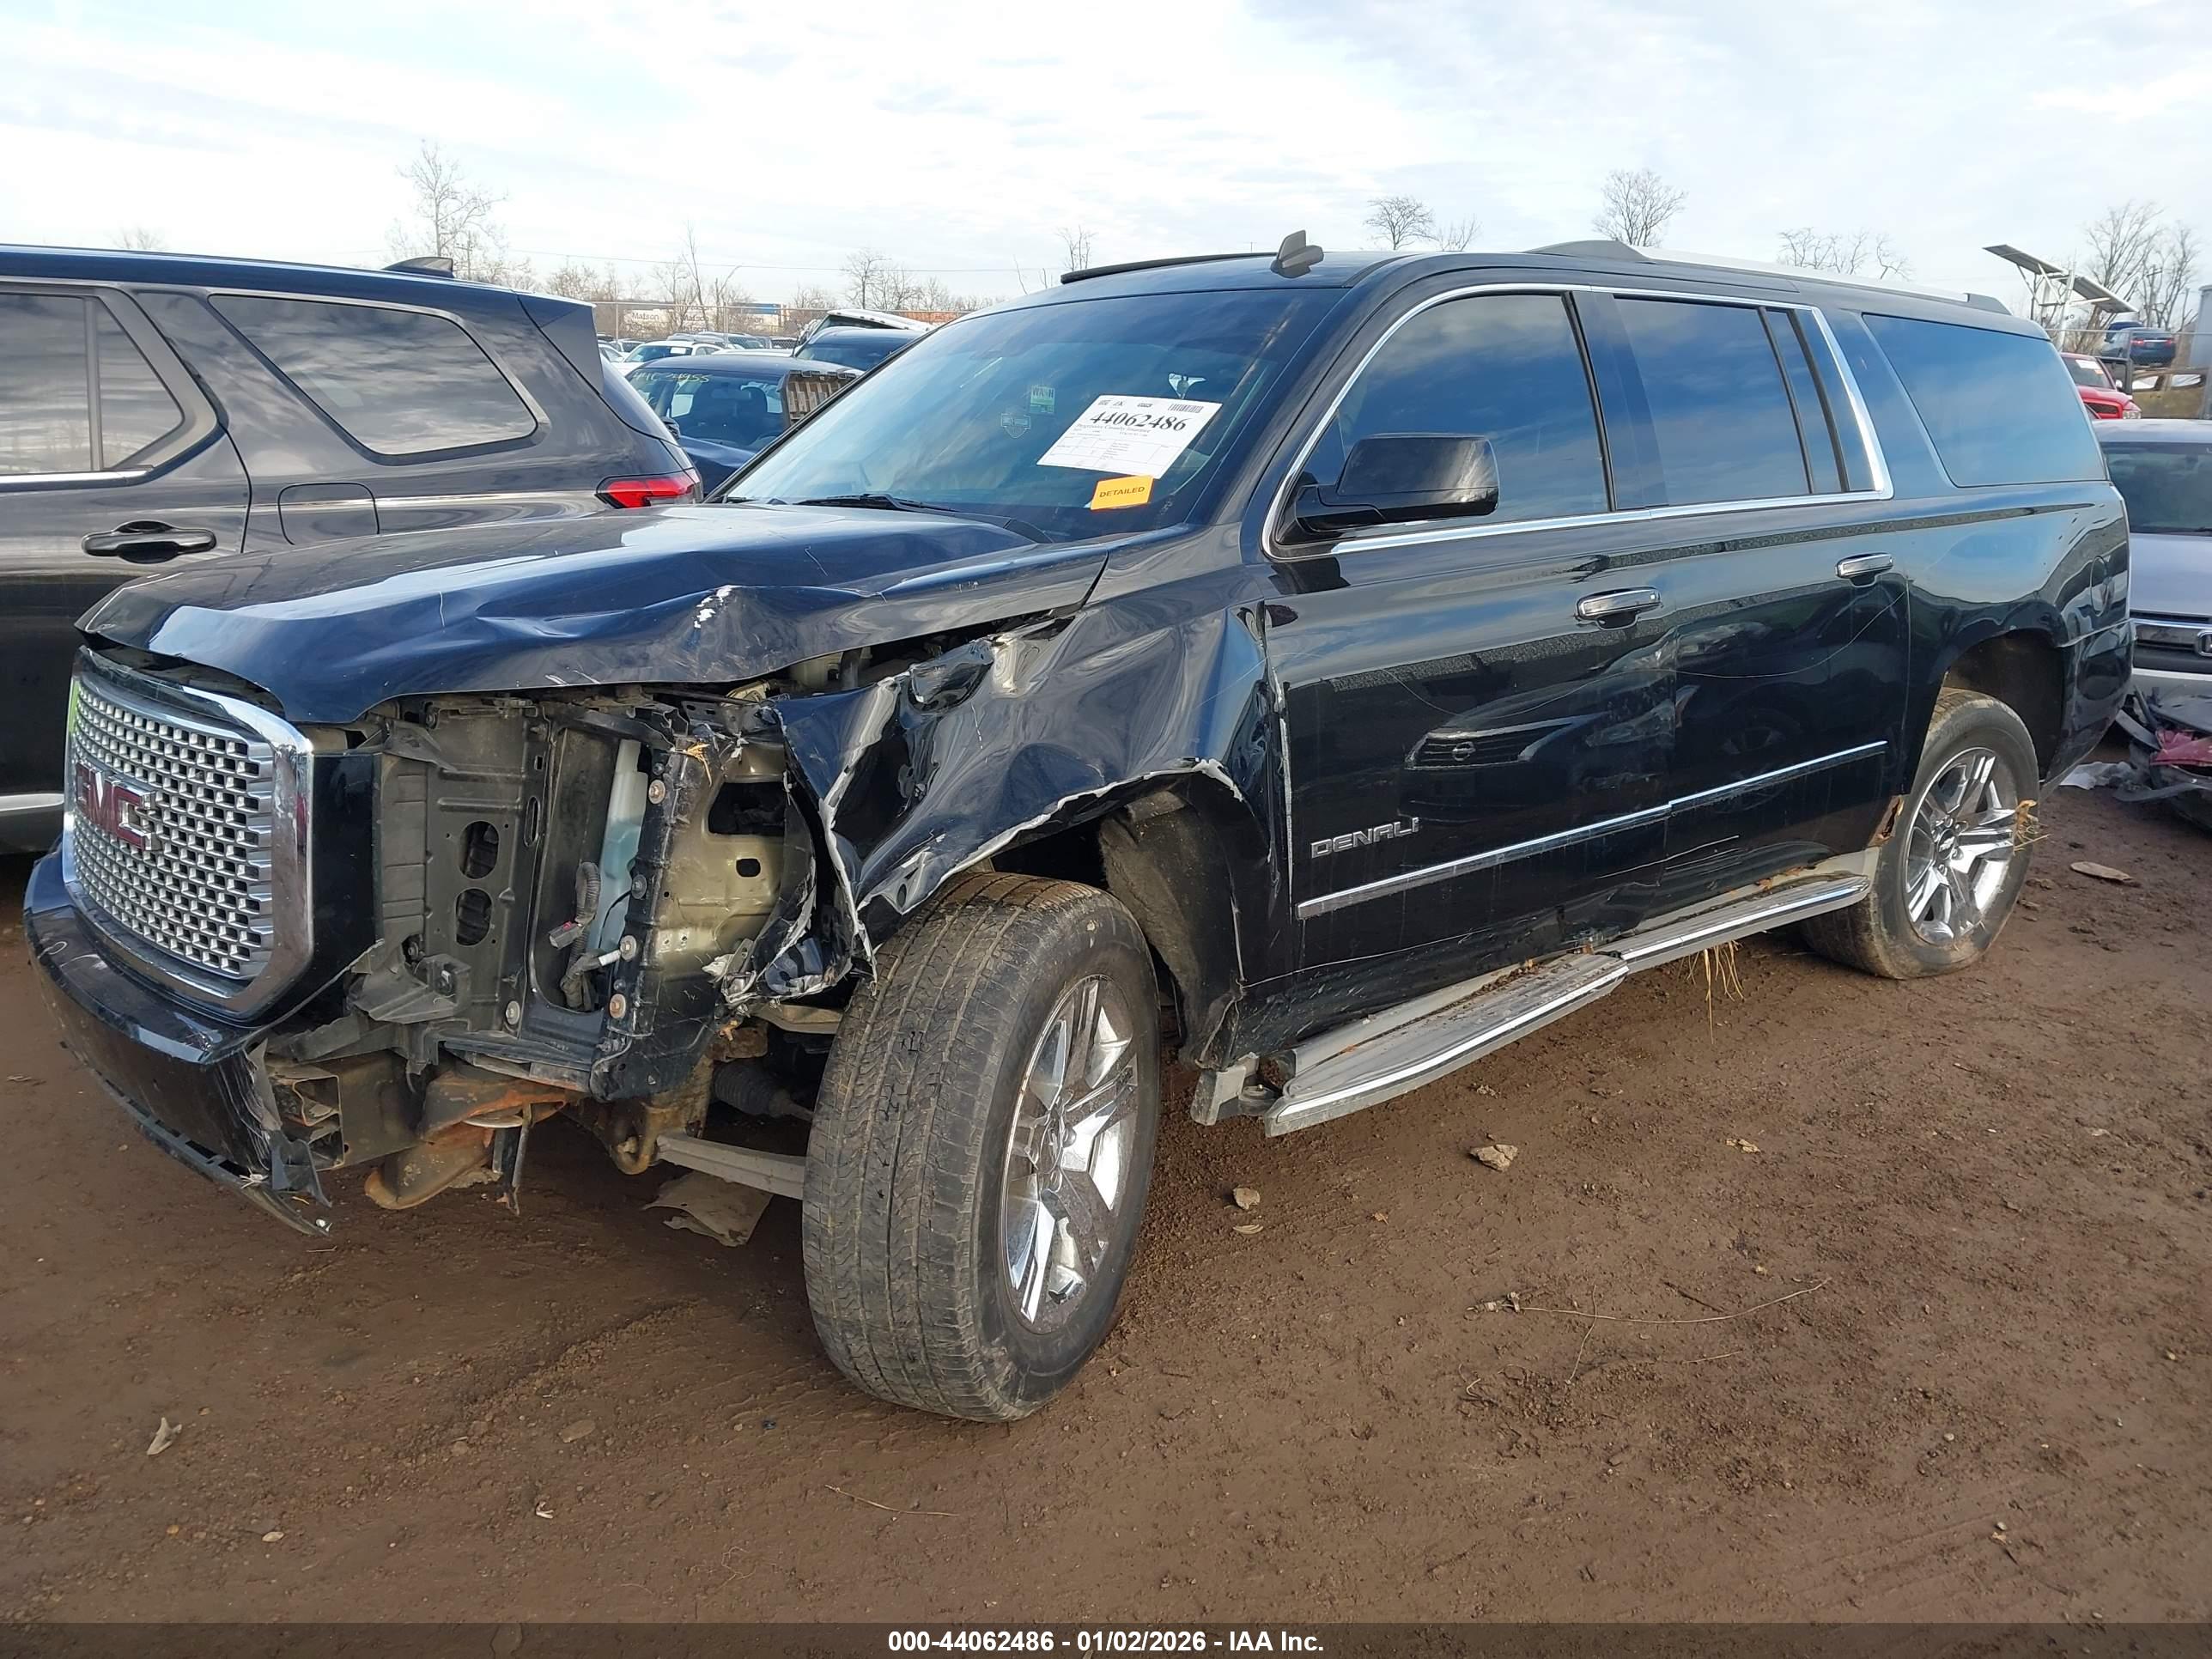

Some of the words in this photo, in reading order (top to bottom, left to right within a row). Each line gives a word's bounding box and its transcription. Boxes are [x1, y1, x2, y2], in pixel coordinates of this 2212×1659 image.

[632, 311, 659, 320] Matson
[1090, 410, 1189, 431] 44062486
[1099, 486, 1146, 498] DETAILED
[76, 760, 153, 852] GMC
[1310, 817, 1419, 859] DENALI
